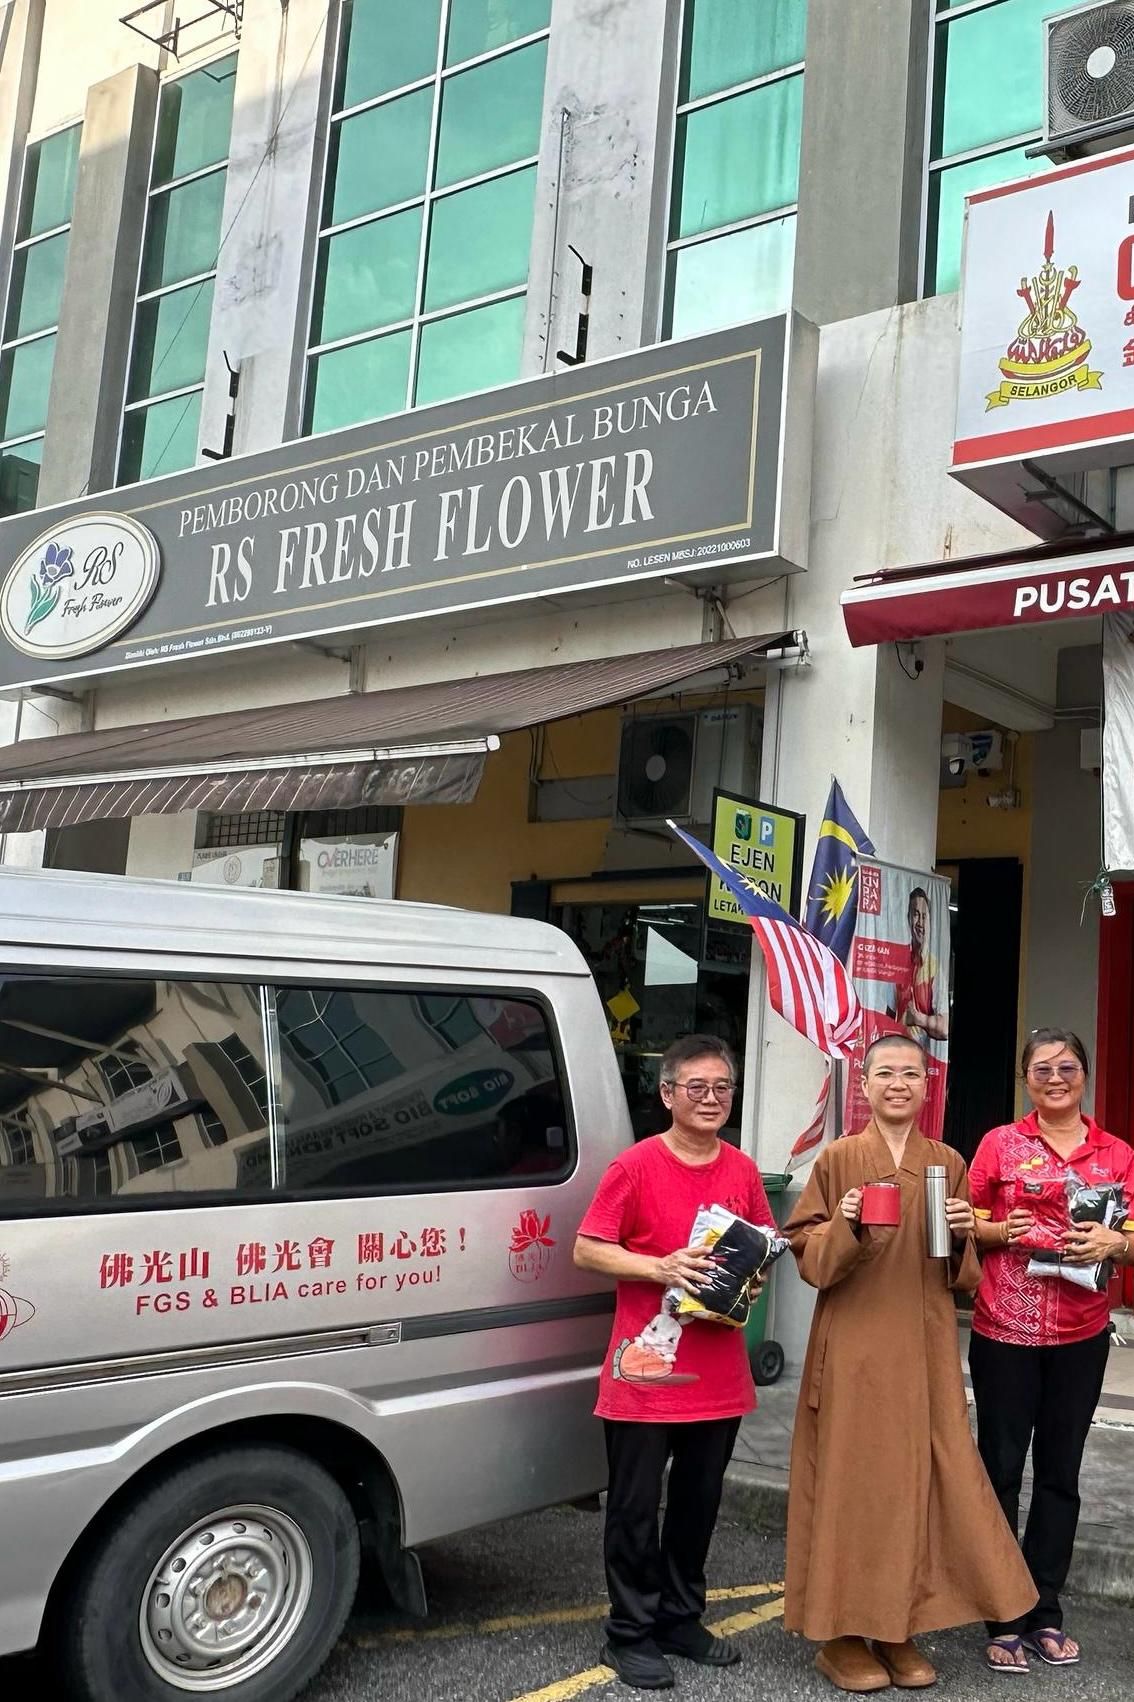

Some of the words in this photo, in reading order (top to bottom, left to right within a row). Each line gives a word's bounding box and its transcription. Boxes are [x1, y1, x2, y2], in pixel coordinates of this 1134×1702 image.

[1010, 374, 1077, 397] SELANGOR
[178, 474, 339, 537] PEMBORONG
[345, 456, 406, 499] DAN
[412, 414, 582, 482] PEMBEKAL
[591, 381, 718, 441] BUNGA
[205, 536, 255, 607] RS
[273, 500, 416, 594] FRESH
[433, 448, 655, 562] FLOWER
[74, 541, 124, 591] RS
[643, 553, 671, 566] LESEN
[731, 843, 775, 872] EJEN
[99, 1247, 210, 1289] 佛光山
[235, 1236, 335, 1276] 佛光會
[136, 1289, 190, 1315] FGS
[202, 1288, 218, 1308] &
[230, 1282, 289, 1304] BLIA
[298, 1279, 347, 1298] care
[356, 1272, 387, 1291] for
[395, 1265, 442, 1292] you!
